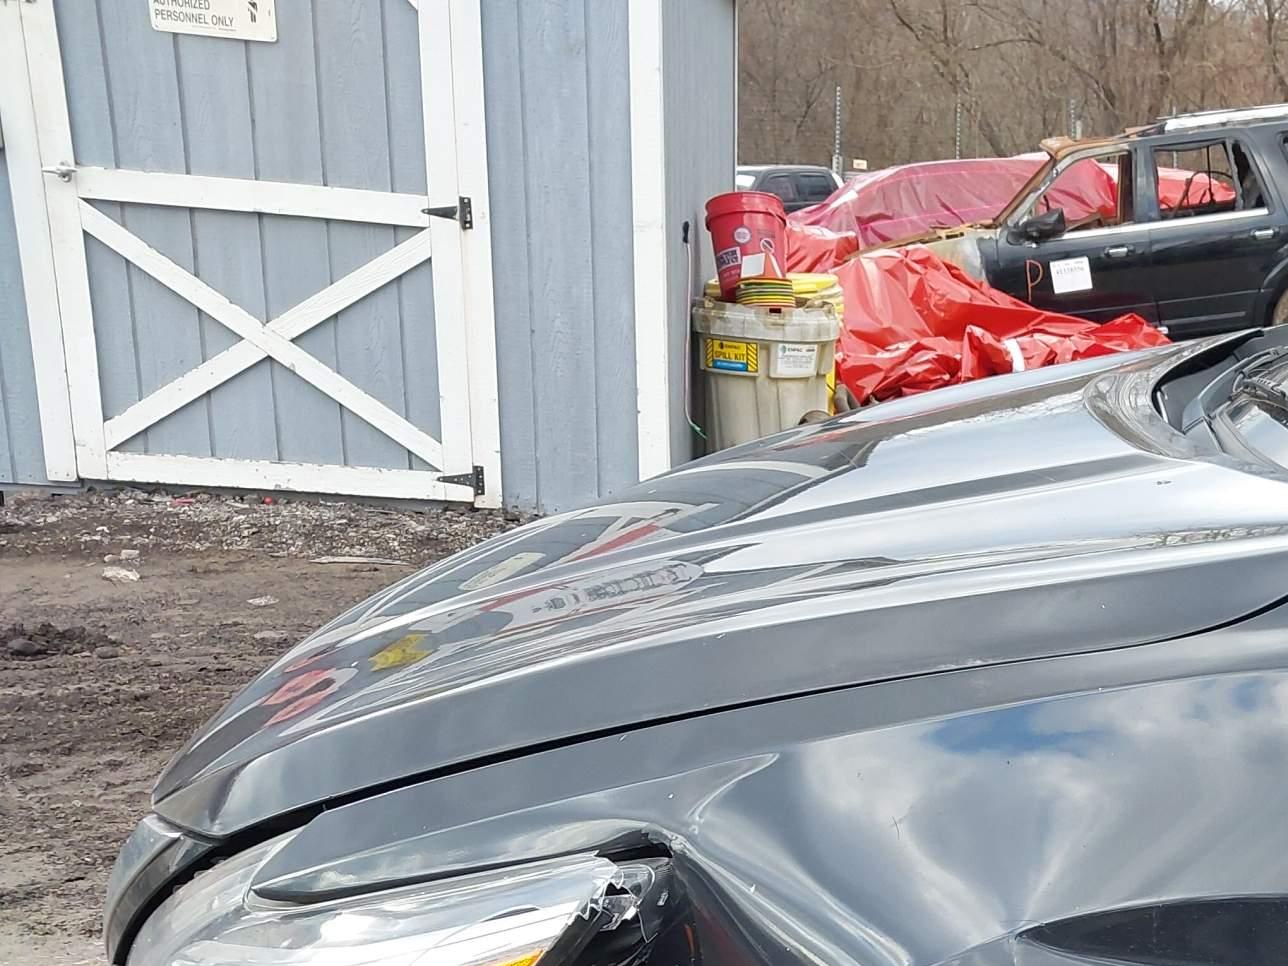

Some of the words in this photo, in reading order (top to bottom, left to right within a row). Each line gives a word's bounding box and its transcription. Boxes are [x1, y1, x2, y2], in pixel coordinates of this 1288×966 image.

[154, 8, 209, 25] PERSONNEL
[210, 15, 234, 27] ONLY
[1026, 259, 1043, 302] P
[714, 351, 733, 360] SPILL
[735, 352, 746, 361] KIT
